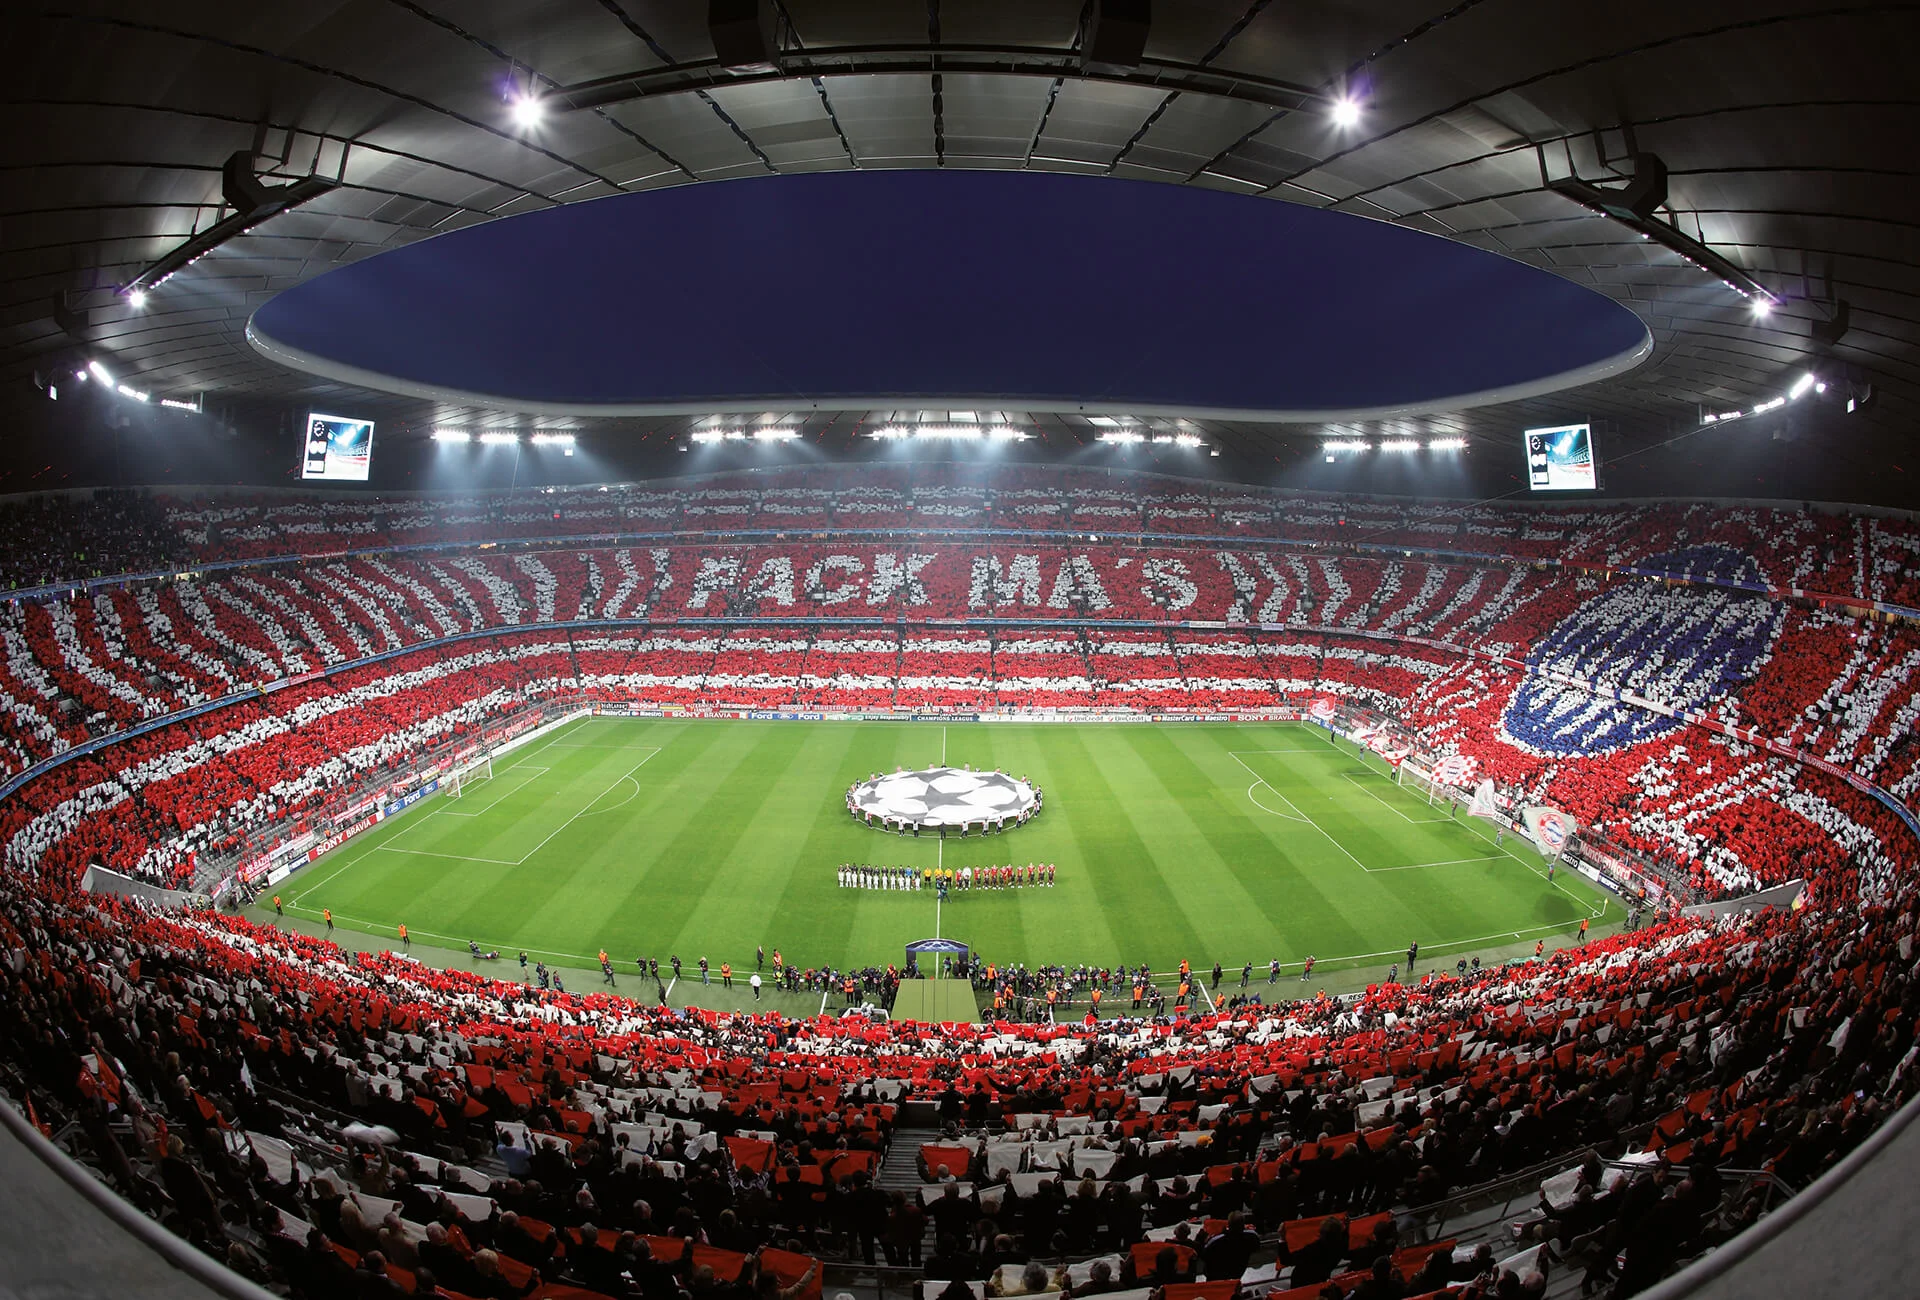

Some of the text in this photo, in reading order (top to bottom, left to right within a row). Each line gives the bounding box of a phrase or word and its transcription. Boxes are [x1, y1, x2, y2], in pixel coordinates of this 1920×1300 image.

[687, 553, 937, 608] PACK
[752, 712, 773, 720] Ford
[404, 790, 420, 806] Ford
[316, 834, 344, 856] SONY
[346, 819, 372, 838] BRAVIA
[1562, 853, 1579, 868] estro
[1348, 993, 1366, 1001] RESP
